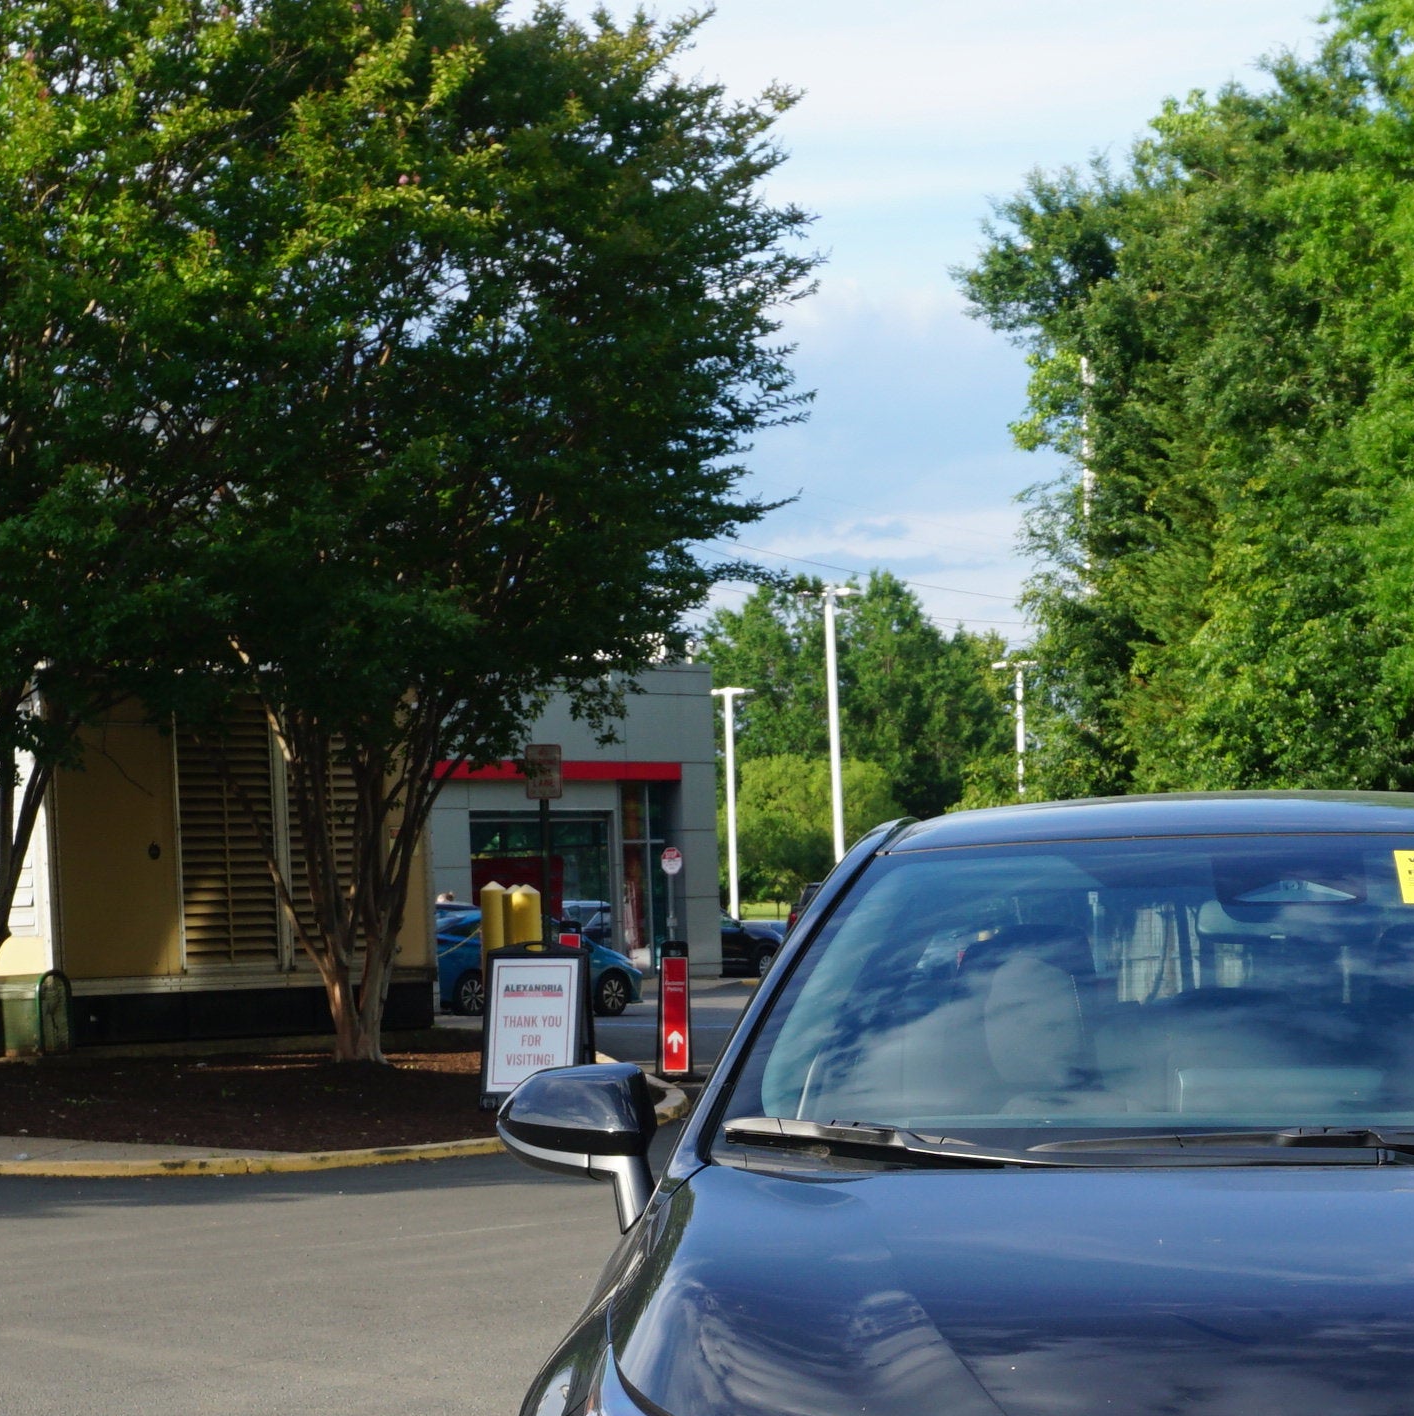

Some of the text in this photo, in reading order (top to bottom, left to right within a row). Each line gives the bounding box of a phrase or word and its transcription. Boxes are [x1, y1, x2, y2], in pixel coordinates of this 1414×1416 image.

[504, 984, 564, 992] ALEXANDRIA
[503, 1016, 562, 1028] THANK YOU
[521, 1035, 541, 1047] FOR
[506, 1054, 555, 1066] VISITING!
